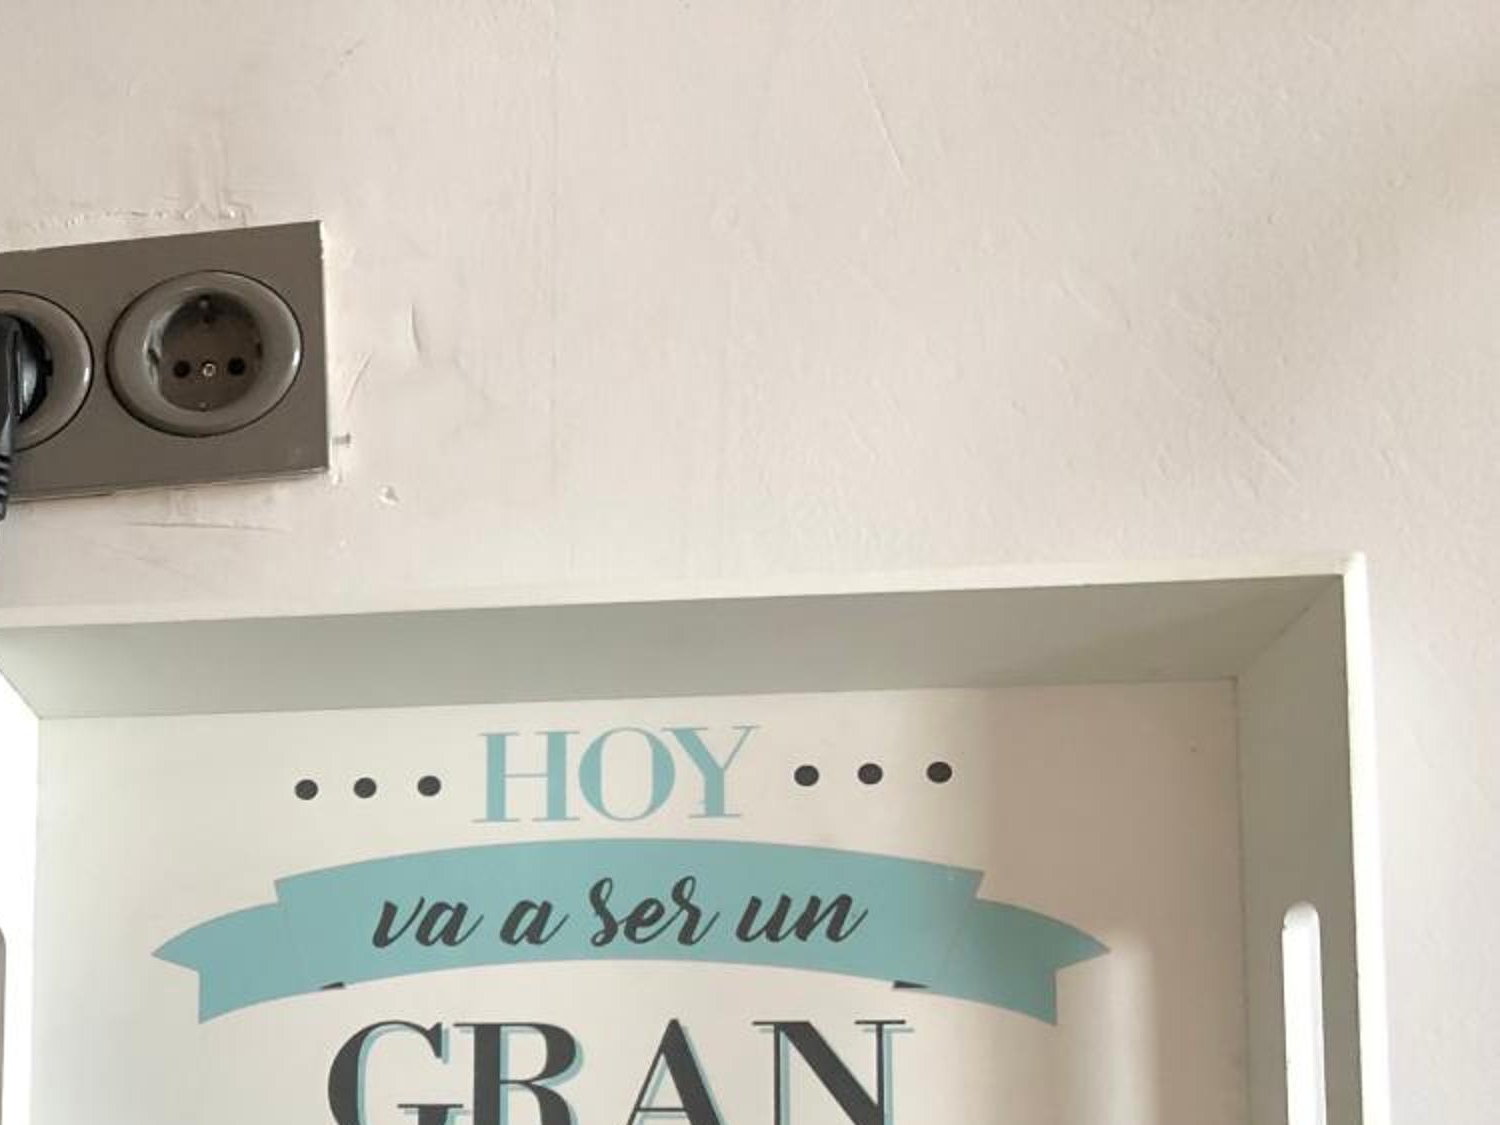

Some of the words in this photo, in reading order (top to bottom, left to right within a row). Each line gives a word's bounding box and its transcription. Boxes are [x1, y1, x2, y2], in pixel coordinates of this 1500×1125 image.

[475, 726, 755, 822] HOY
[371, 896, 484, 950] va
[500, 900, 569, 946] a
[735, 892, 869, 943] un
